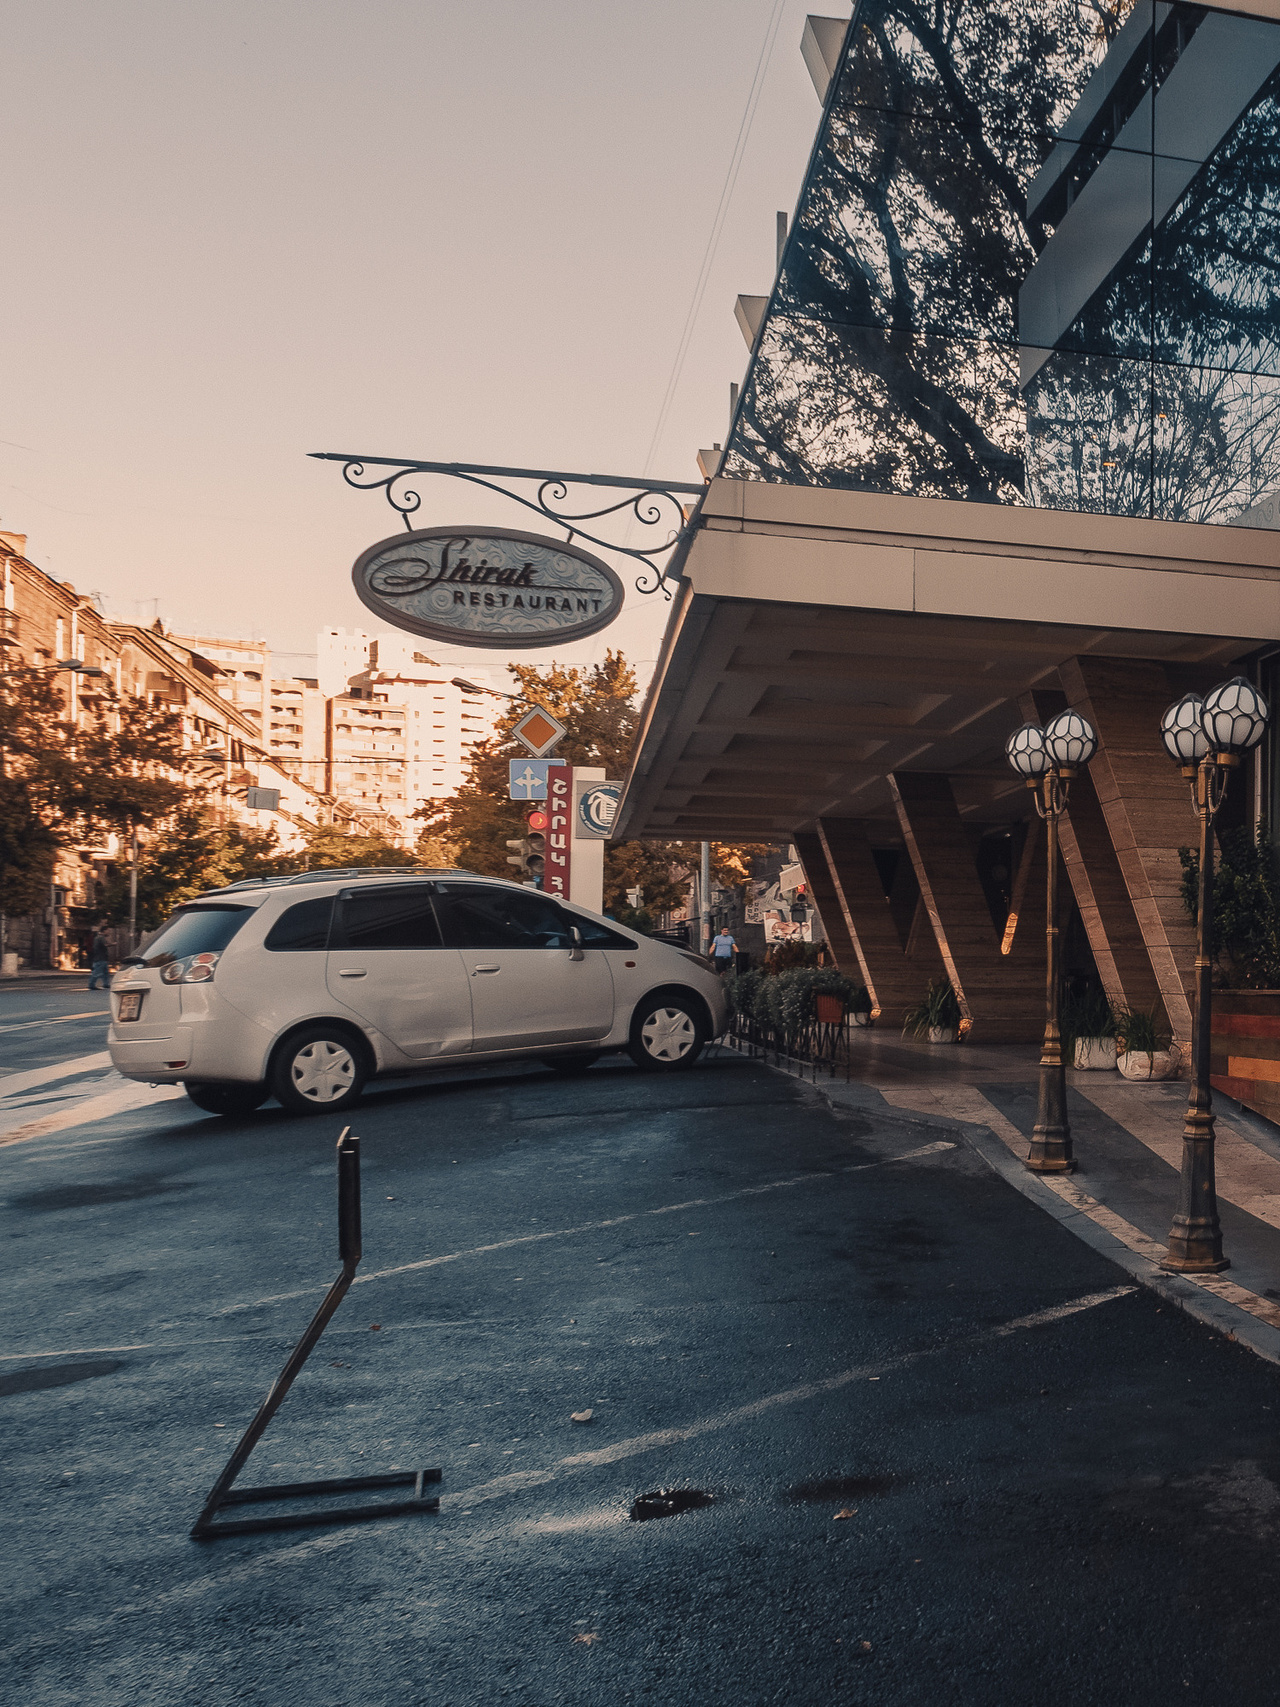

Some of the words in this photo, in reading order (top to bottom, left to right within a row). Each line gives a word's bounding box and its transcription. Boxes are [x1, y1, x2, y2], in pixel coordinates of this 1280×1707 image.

[368, 537, 540, 597] Shirak
[453, 590, 603, 613] RESTAURANT
[550, 778, 568, 867] ՇԻՐԱԿ
